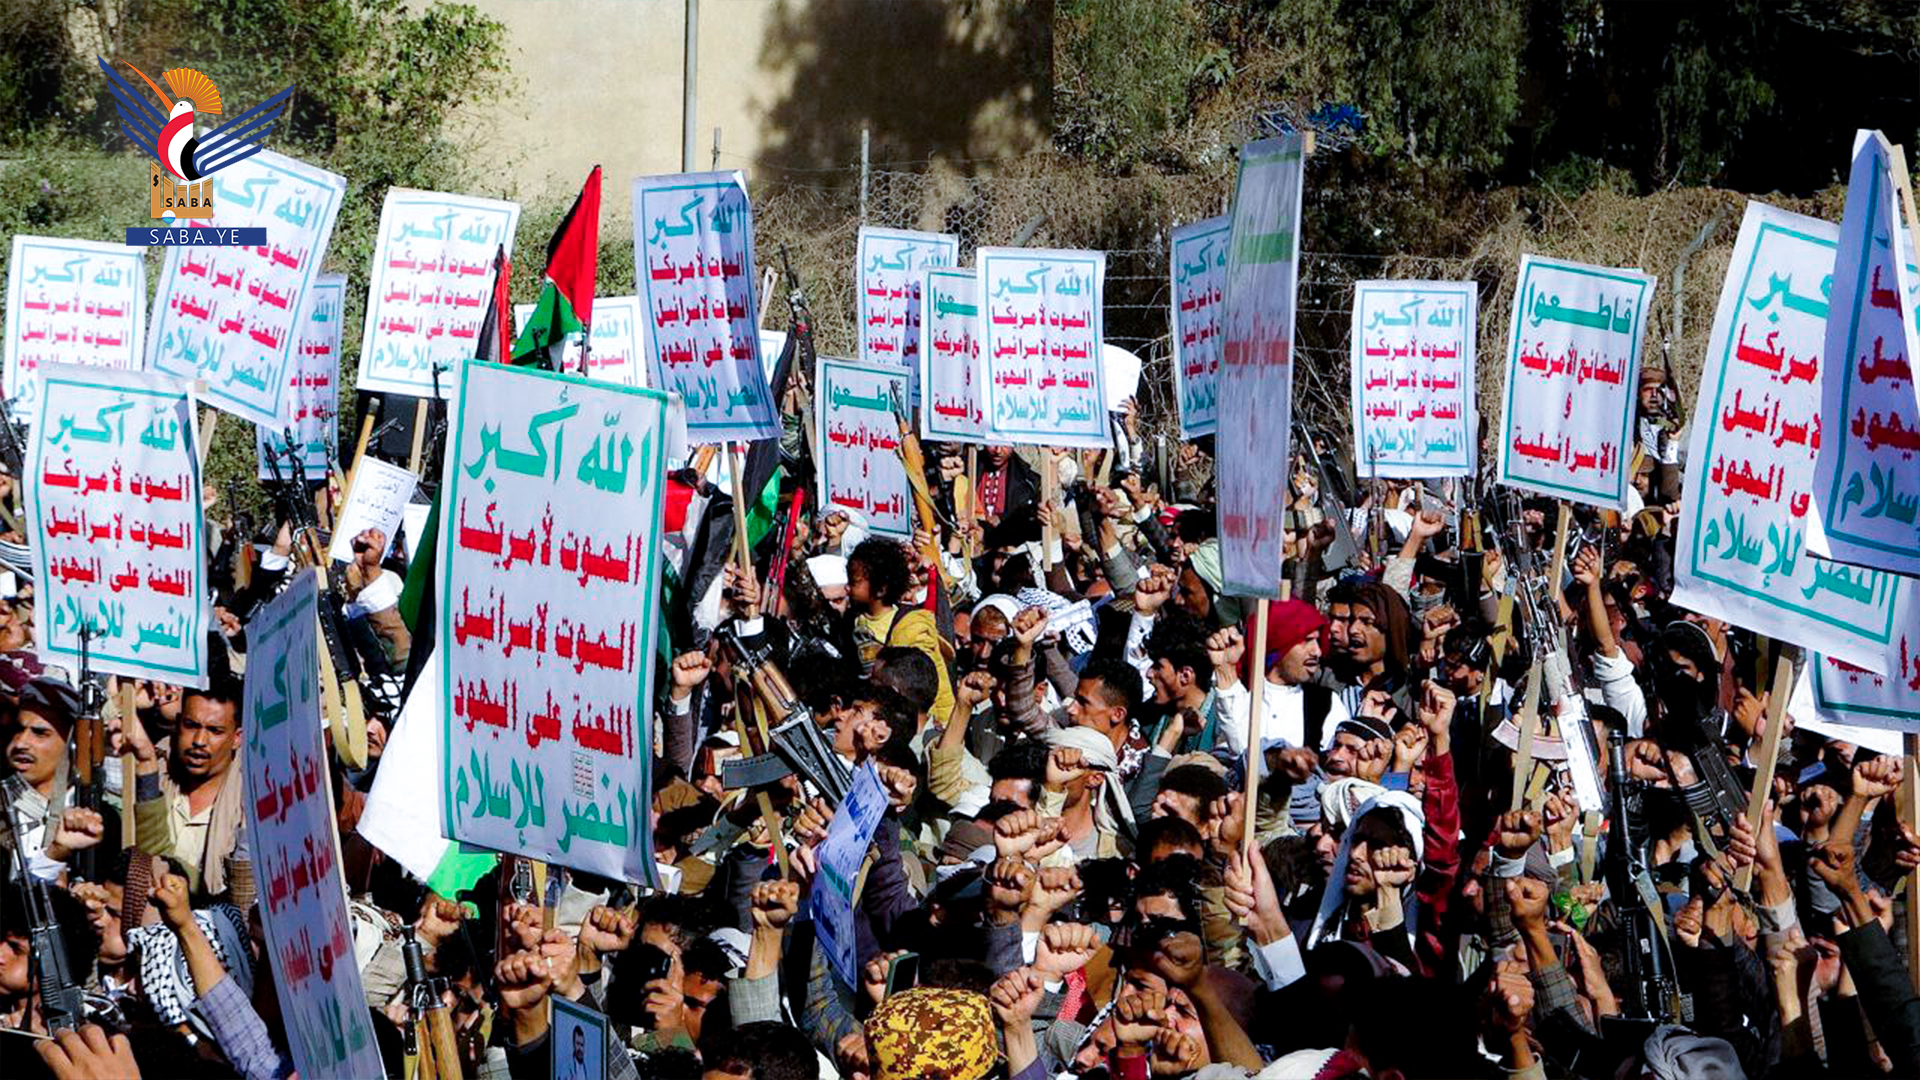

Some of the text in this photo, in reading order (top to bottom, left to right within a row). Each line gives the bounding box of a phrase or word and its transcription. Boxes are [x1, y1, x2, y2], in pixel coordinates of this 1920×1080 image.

[273, 187, 322, 231] الله
[392, 207, 500, 246] الله أكبر
[648, 190, 704, 250] أكبر
[24, 253, 131, 288] الله أكبر
[389, 249, 446, 275] لأمريكا
[650, 246, 745, 286] الموت لأمريكا
[866, 242, 917, 276] أكبر
[1176, 238, 1215, 285] أكبر
[180, 249, 297, 310] الموت لإسرائيل
[384, 281, 488, 310] الموت لإسرائيل
[991, 262, 1090, 302] الله أكبر
[24, 290, 130, 319] الموت لأمريكا
[171, 292, 218, 323] اليهود
[219, 311, 245, 334] على
[656, 294, 750, 328] الموت لإسرائيل
[992, 303, 1091, 331] الموت لأمريكا
[1365, 295, 1463, 334] الله أكبر
[1527, 280, 1633, 335] قاطعوا
[83, 330, 128, 348] الموت
[249, 315, 286, 351] اللعنة
[379, 316, 482, 340] اللعنة على اليهود
[593, 313, 629, 339] الله
[161, 325, 225, 378] للإسلام
[661, 336, 698, 369] اليهود
[703, 336, 723, 368] على
[868, 336, 899, 355] اليهود
[994, 335, 1047, 361] لإسرائيل
[1051, 340, 1092, 361] الموت
[1365, 335, 1462, 362] الموت لأمريكا
[223, 355, 280, 395] النصر
[965, 364, 971, 387] و
[995, 368, 1094, 390] اللعنة على اليهود
[1365, 368, 1461, 392] الموت لإسرائيل
[1520, 339, 1626, 390] البضائع الأمريكية
[47, 393, 134, 453] أكبر
[996, 393, 1098, 428] النصر للإسلام
[1365, 399, 1462, 422] اللعنة على اليهود
[1563, 391, 1572, 419] و
[463, 385, 652, 496] الله أكبر
[1367, 426, 1463, 459] النصر للإسلام
[1513, 425, 1617, 479] الإسرائيلية
[43, 456, 190, 503] الموت لأمريكا
[862, 458, 869, 478] و
[1711, 454, 1784, 506] اليهود
[46, 505, 191, 550] الموت لإسرائيل
[460, 497, 553, 571] لأمريكا
[560, 529, 642, 588] الموت
[1703, 507, 1802, 589] للإسلام
[50, 555, 192, 597] اللعنة على اليهود
[130, 604, 191, 653] النصر
[455, 584, 636, 675] الموت لإسرائيل
[454, 671, 633, 760] اللعنة على اليهود
[455, 747, 546, 849] للإسلام
[557, 773, 638, 854] النصر
